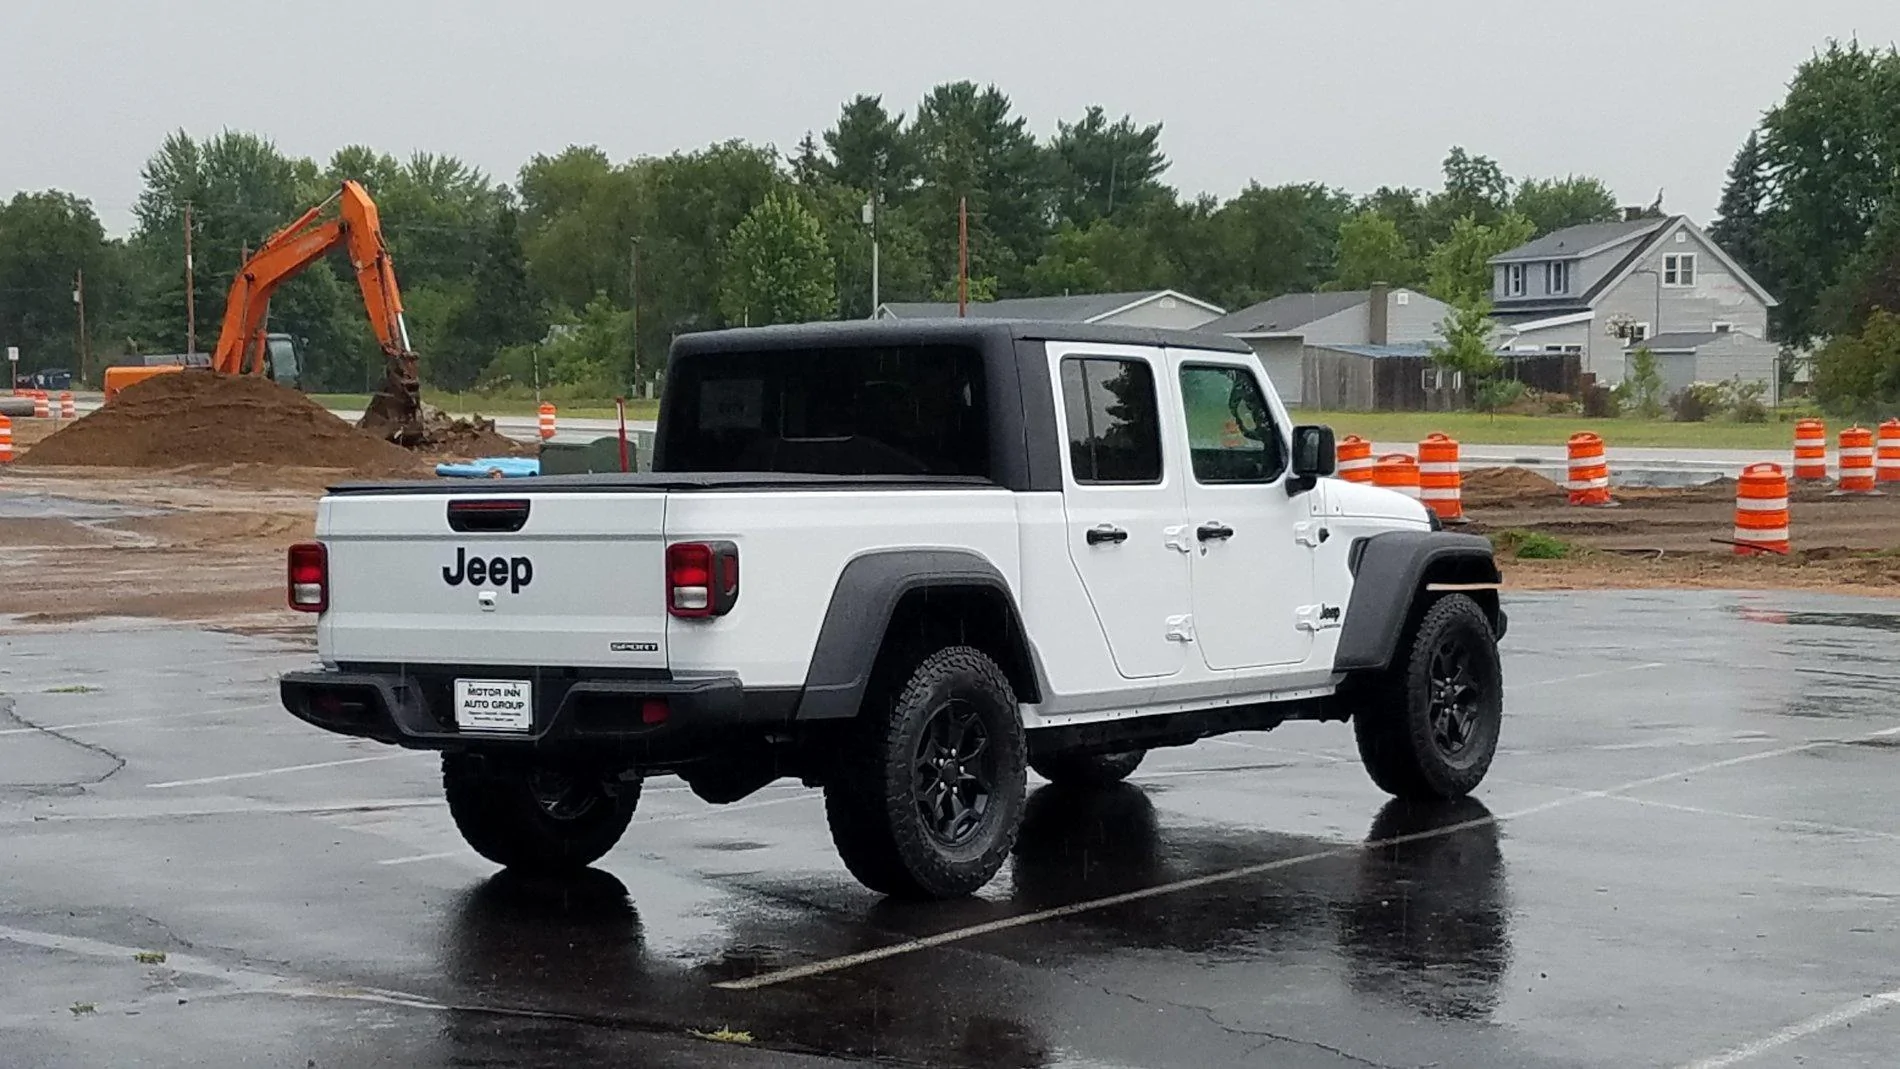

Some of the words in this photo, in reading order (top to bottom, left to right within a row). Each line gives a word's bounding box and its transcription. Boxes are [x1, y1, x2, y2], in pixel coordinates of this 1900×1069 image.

[442, 547, 533, 593] Jeep
[1319, 603, 1341, 622] Jeep
[611, 642, 658, 651] SPORT
[467, 688, 501, 697] MOTOR
[504, 689, 521, 697] INN
[464, 700, 489, 709] AUTO
[491, 700, 525, 710] GROUP
